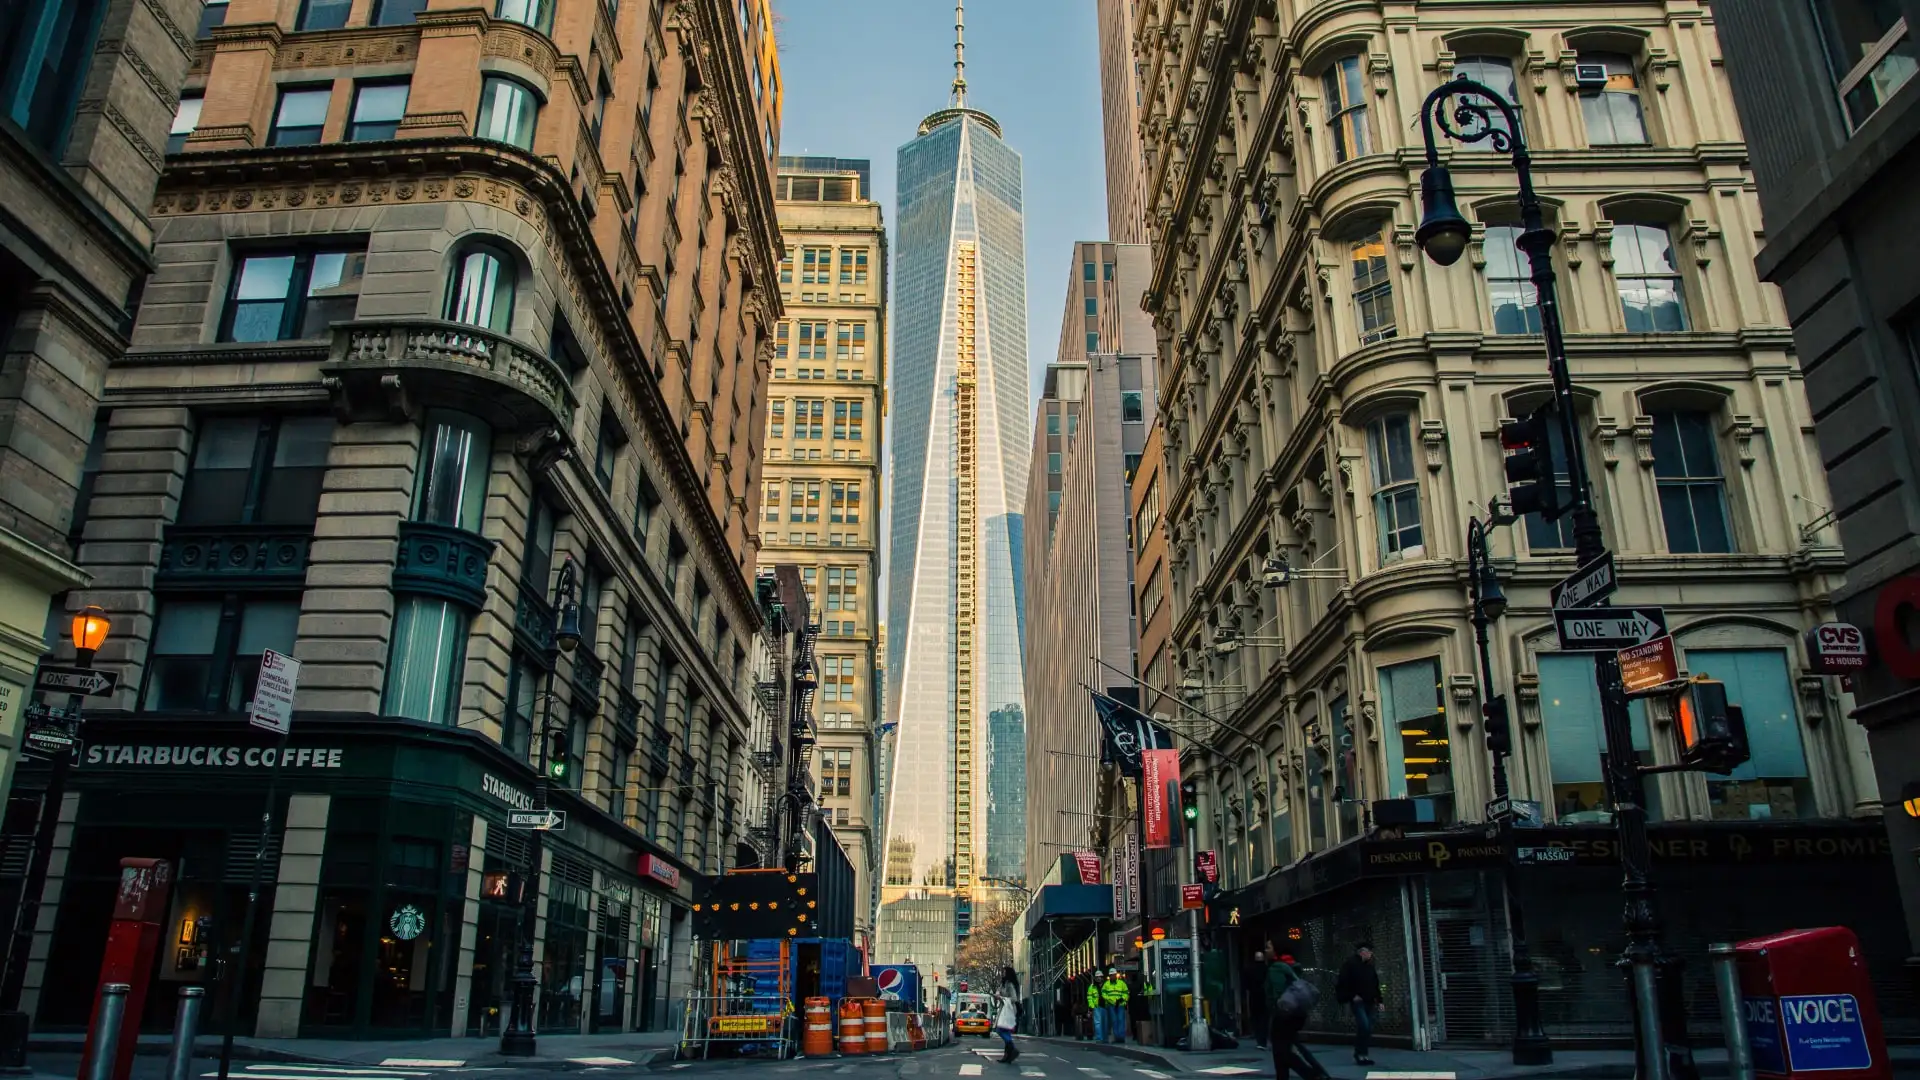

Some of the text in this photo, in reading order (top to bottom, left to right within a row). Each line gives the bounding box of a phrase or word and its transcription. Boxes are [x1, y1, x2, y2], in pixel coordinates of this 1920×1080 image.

[1561, 569, 1607, 609] ONE WAY
[1573, 621, 1649, 637] ONE WAY
[1820, 627, 1860, 643] CVS
[1621, 642, 1664, 661] NO STANDING
[1822, 644, 1861, 652] pharmacy
[265, 652, 273, 667] 3
[1824, 657, 1863, 666] 24 HOURS
[46, 673, 105, 690] ONE WAY
[87, 744, 343, 767] STARBUCKS COFFEE
[482, 773, 530, 810] STARBUCKS
[1146, 776, 1154, 809] Manhattan
[516, 815, 557, 824] ONE WAY
[1147, 809, 1156, 834] Hospital
[1370, 851, 1424, 865] DESIGNER
[1536, 851, 1569, 861] NASSAU
[1547, 839, 1709, 858] ESINER
[1128, 834, 1137, 911] Lucille Roberts
[1114, 847, 1123, 919] Lucille Roberts
[1788, 999, 1856, 1025] VOICE
